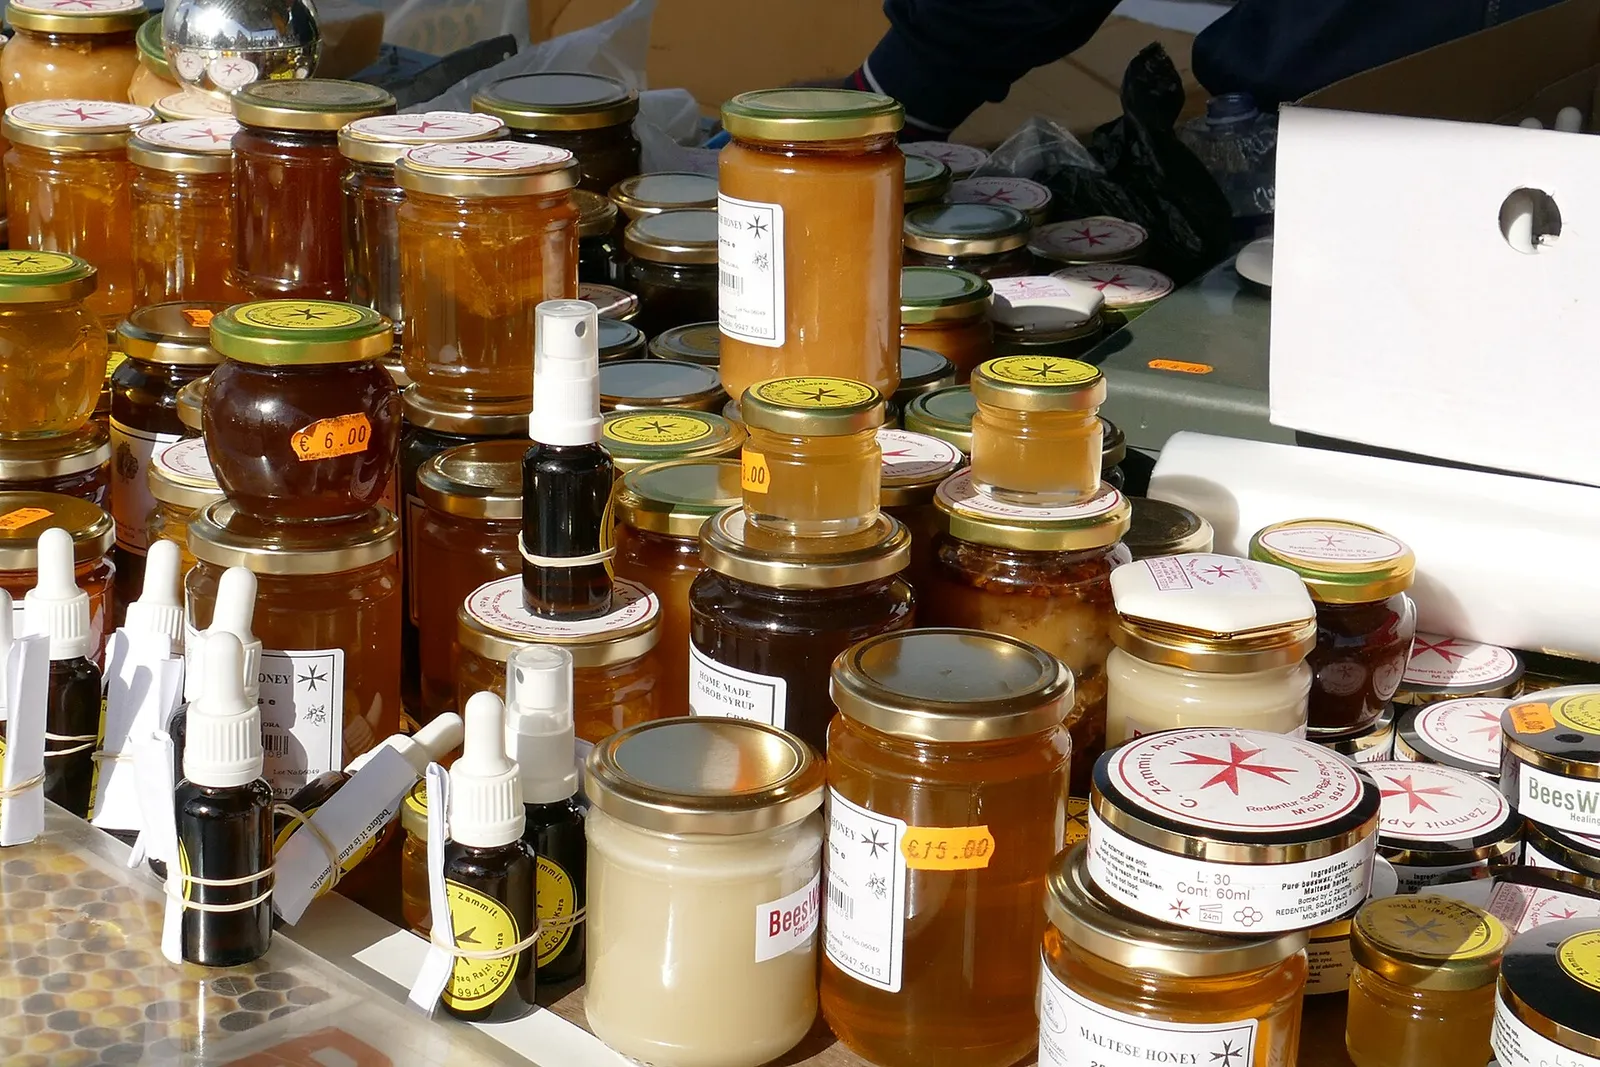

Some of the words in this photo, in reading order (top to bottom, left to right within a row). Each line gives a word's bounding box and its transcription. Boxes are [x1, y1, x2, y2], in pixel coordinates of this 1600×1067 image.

[299, 435, 310, 452] €
[324, 425, 367, 449] 6.00
[259, 674, 291, 685] ONEY
[699, 670, 721, 689] HOME
[723, 683, 752, 699] MADE
[697, 681, 721, 700] CAROB
[722, 695, 755, 711] SYRUP
[1136, 752, 1172, 796] Zammit
[1328, 781, 1348, 802] 9947
[831, 816, 856, 841] HONEY
[1425, 807, 1488, 830] Zammit
[1213, 873, 1231, 886] 30
[1281, 882, 1300, 891] Pure
[1304, 883, 1331, 896] Maltese
[1216, 888, 1251, 901] 60ml
[1298, 894, 1319, 905] Bottled
[1320, 892, 1327, 900] by
[1320, 906, 1335, 916] 9947
[457, 983, 487, 998] 9947
[490, 955, 512, 986] 5613
[859, 961, 882, 977] 5613
[1079, 1025, 1142, 1059] MALTESE
[1146, 1048, 1200, 1065] HONEY
